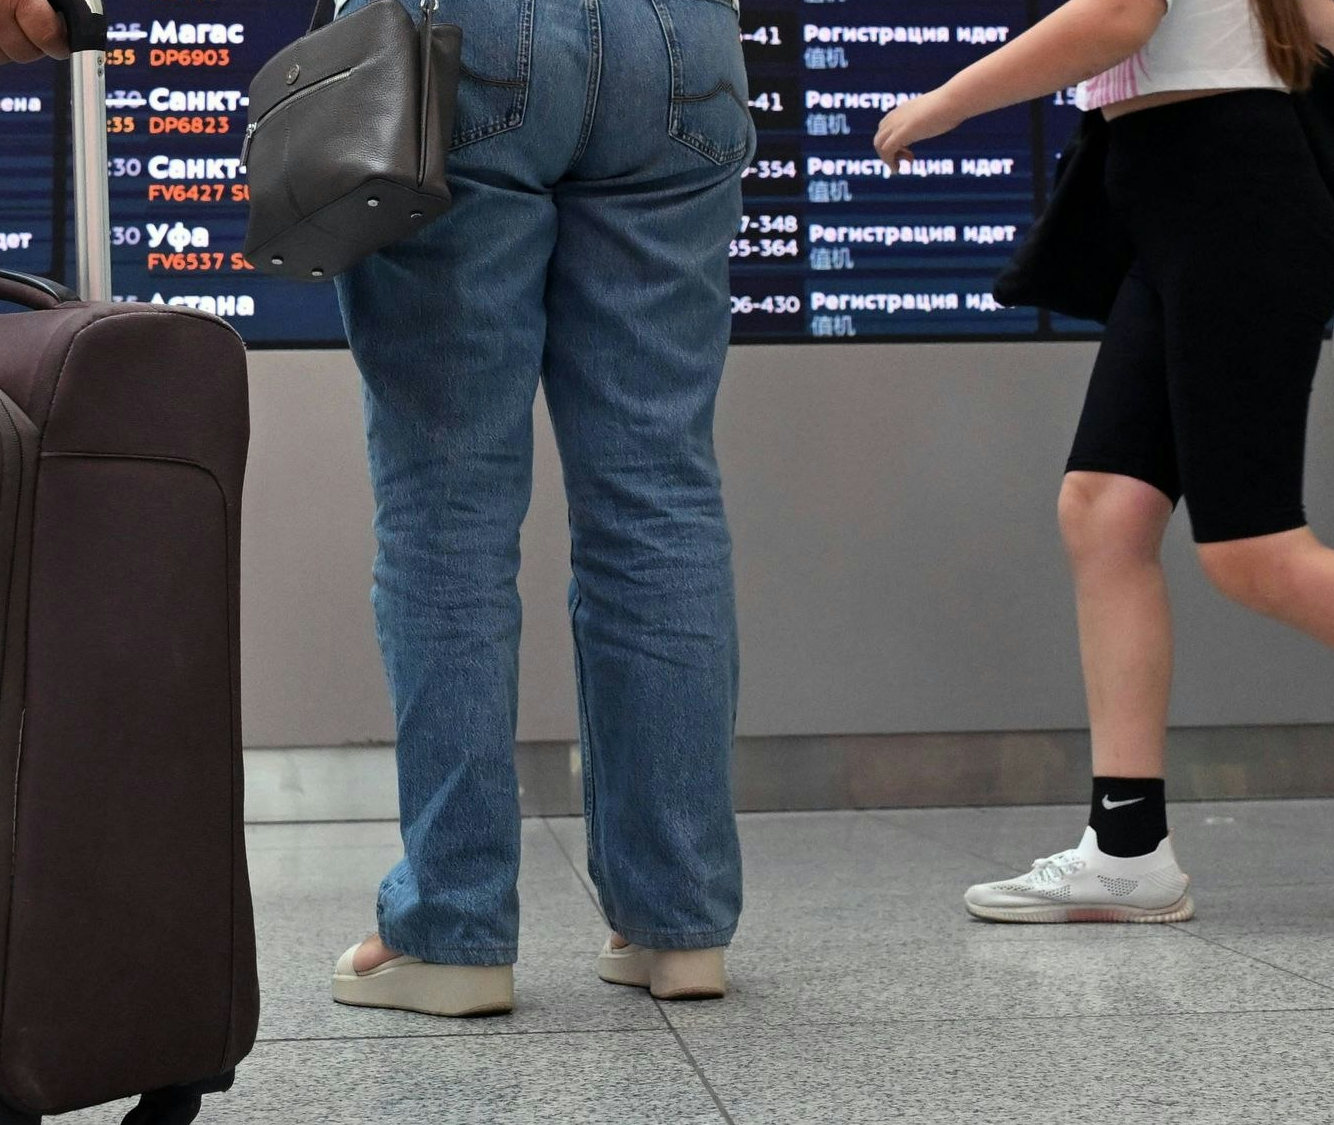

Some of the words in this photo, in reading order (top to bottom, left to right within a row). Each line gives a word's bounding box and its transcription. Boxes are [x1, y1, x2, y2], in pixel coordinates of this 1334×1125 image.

[149, 20, 244, 45] Магас
[150, 49, 229, 66] DP6903
[146, 222, 209, 252] Уфа
